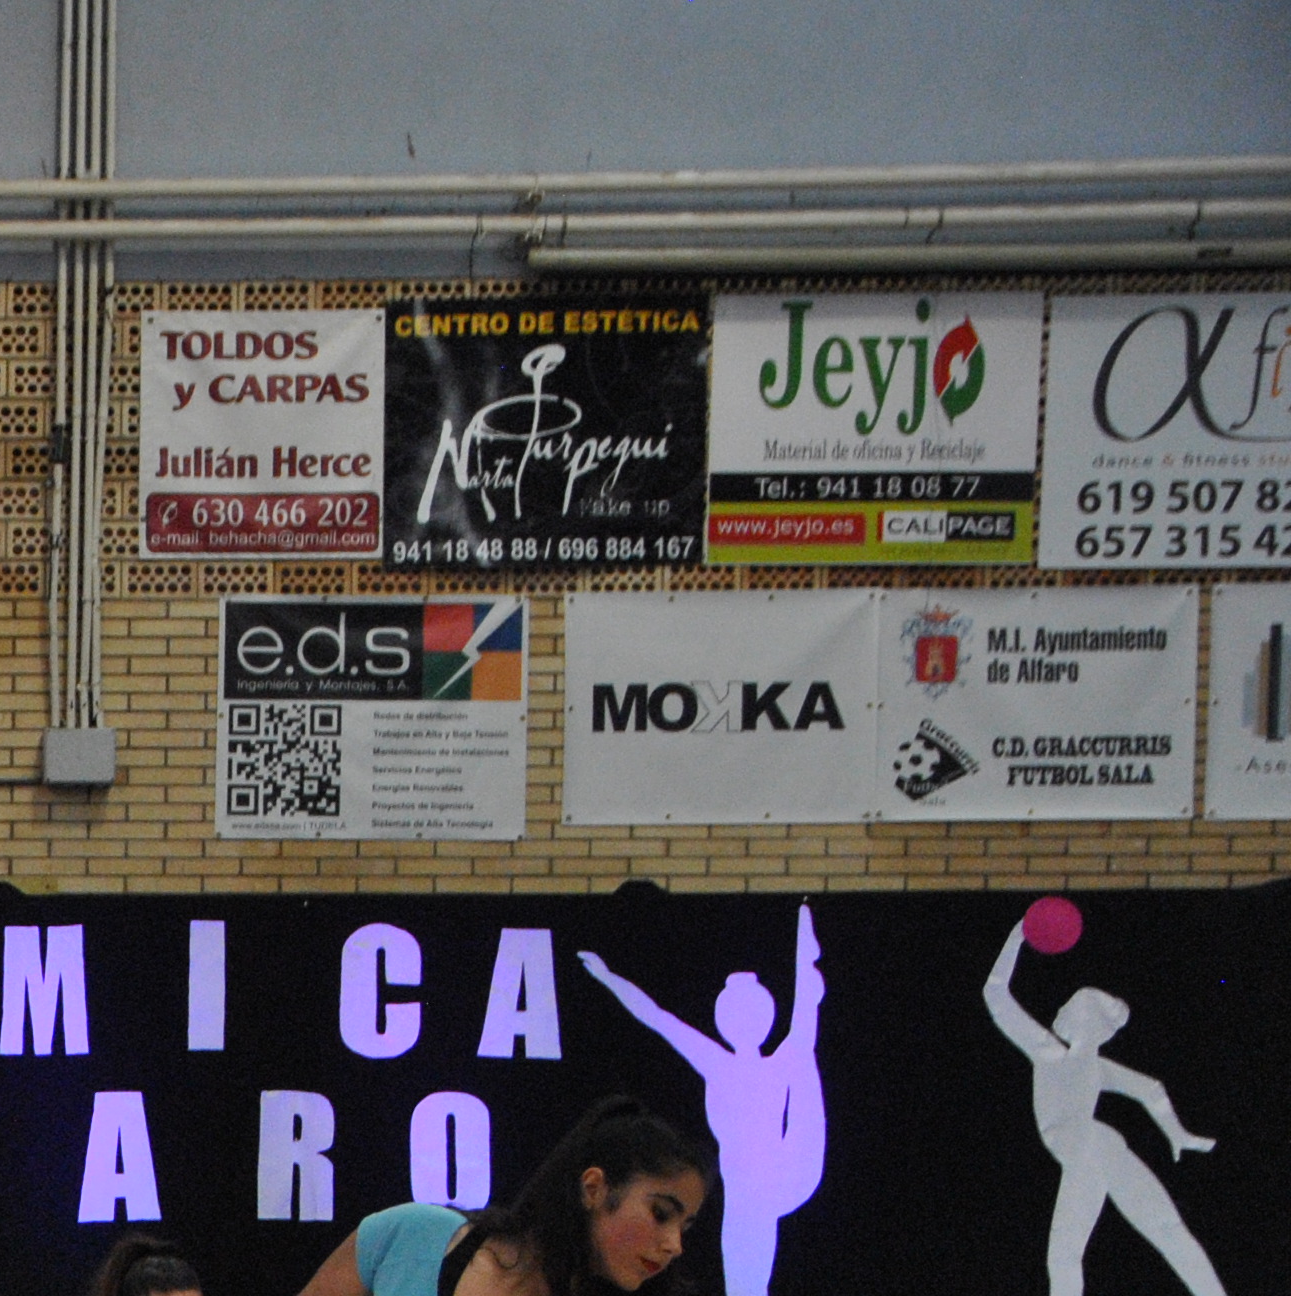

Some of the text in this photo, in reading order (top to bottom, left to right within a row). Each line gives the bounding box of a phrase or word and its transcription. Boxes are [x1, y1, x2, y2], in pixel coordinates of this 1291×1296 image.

[394, 312, 510, 337] CENTRO
[518, 311, 555, 334] DE
[161, 330, 318, 361] TOLDOS
[758, 299, 986, 436] Jeyjo
[173, 373, 370, 411] y CARPAS
[155, 446, 371, 479] Julián Herce
[763, 438, 986, 464] Material de oficina y Reciclaje
[754, 476, 982, 499] Tel.: 941 18 08 77
[1077, 479, 1154, 515] 619
[1165, 479, 1244, 515] 507
[191, 498, 369, 527] 630 466 202
[208, 528, 376, 550] behacha@gmail.com
[716, 515, 1013, 540] www.jeyjo.es CALIPAGE
[393, 536, 695, 564] 941 18 48 88 / 696 884 167
[1075, 524, 1151, 560] 657
[1164, 524, 1242, 560] 315
[236, 611, 412, 675] e.d.s
[1034, 625, 1169, 656] Ayuntamiento
[986, 657, 1080, 684] de Alfaro
[305, 682, 315, 694] y
[991, 734, 1173, 760] C.D. GRACCURRIS
[1006, 762, 1155, 788] FUTBOL SALA
